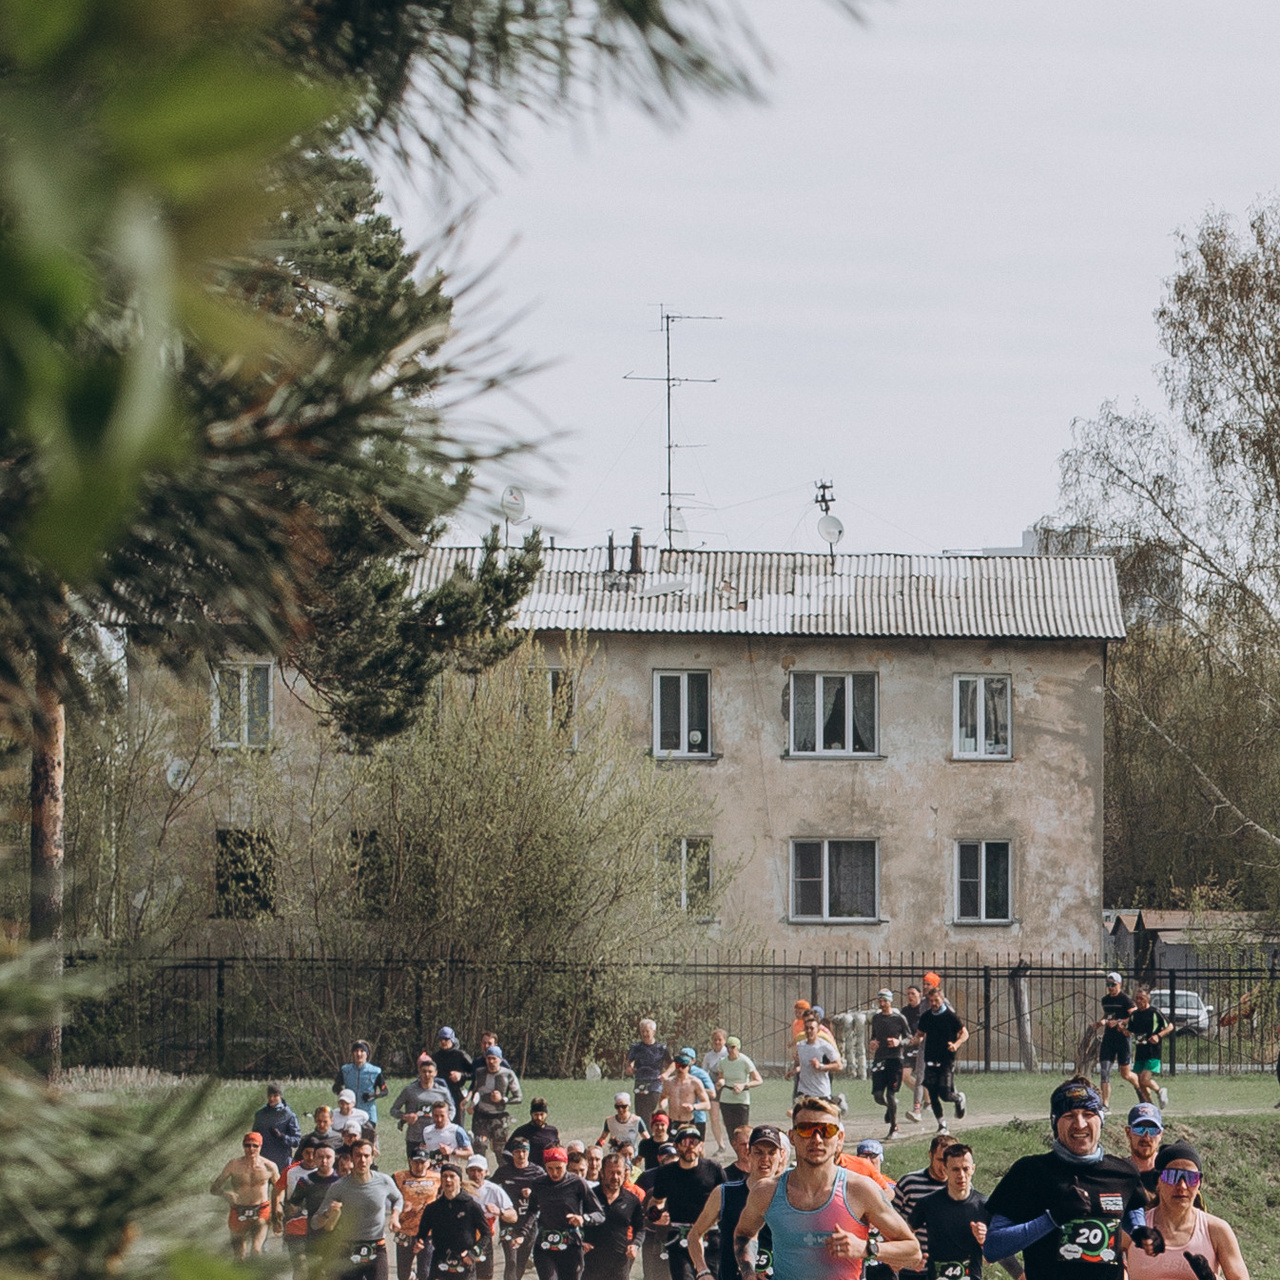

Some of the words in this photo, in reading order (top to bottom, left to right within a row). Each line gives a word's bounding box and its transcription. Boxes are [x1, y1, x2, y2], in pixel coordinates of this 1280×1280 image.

[547, 1233, 560, 1243] 69
[1075, 1228, 1102, 1245] 20
[361, 1246, 368, 1256] 8
[945, 1266, 961, 1277] 44
